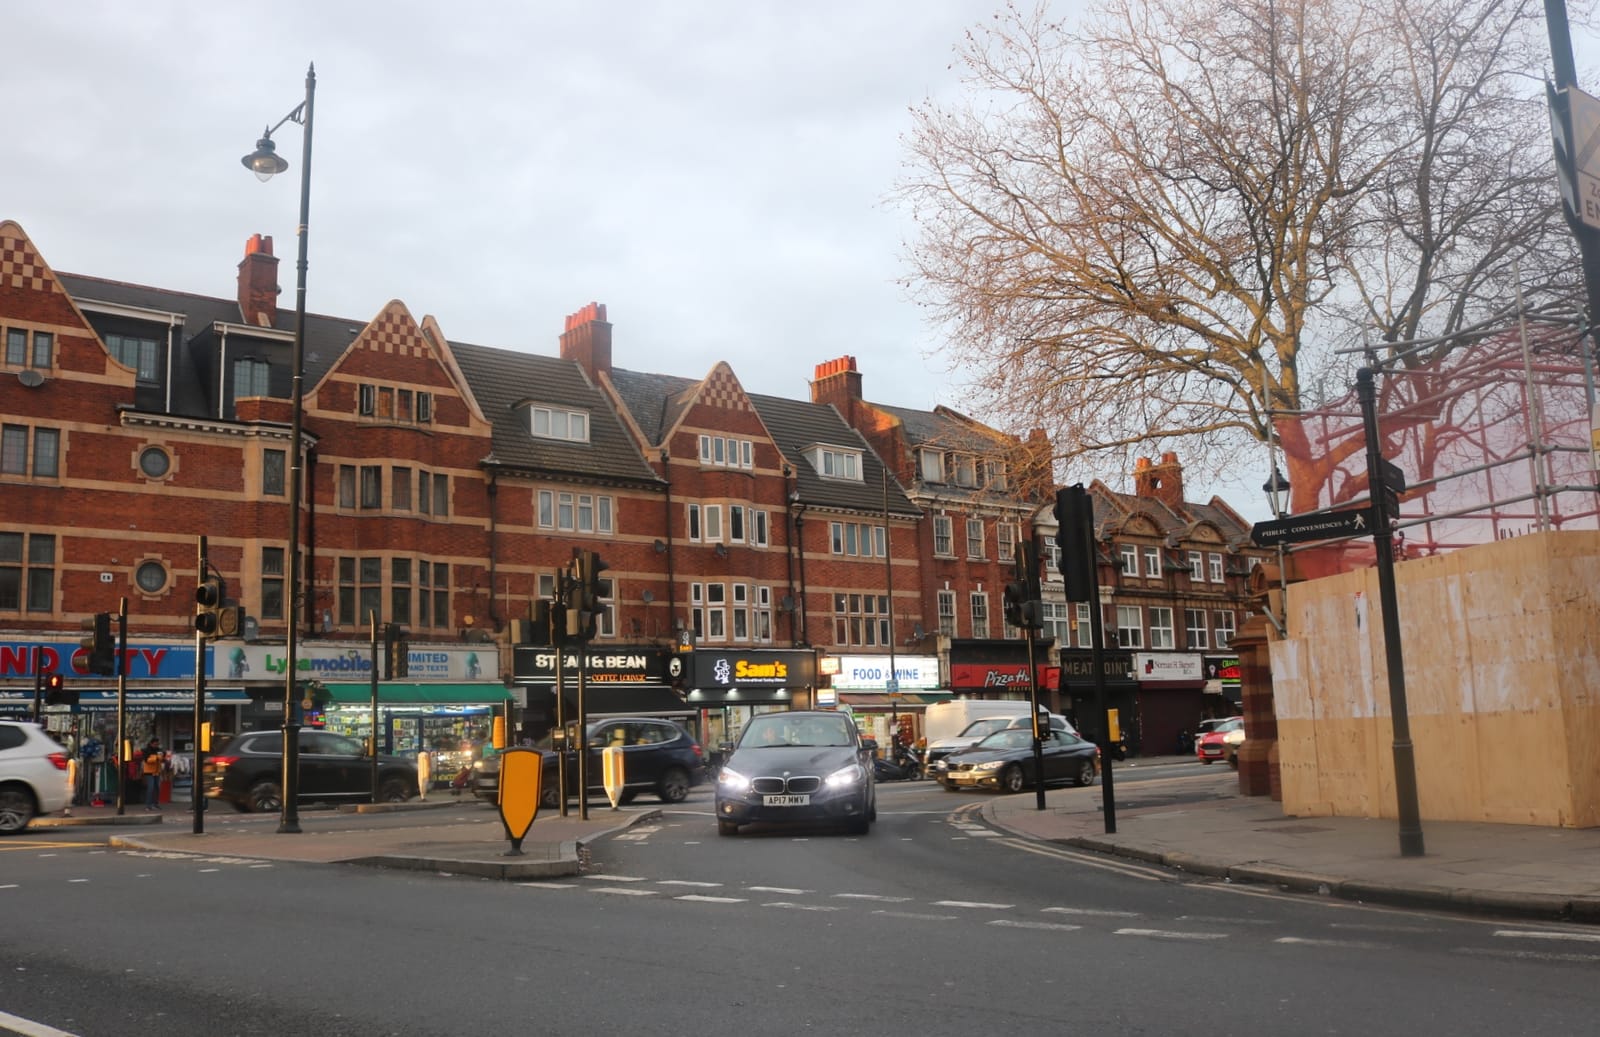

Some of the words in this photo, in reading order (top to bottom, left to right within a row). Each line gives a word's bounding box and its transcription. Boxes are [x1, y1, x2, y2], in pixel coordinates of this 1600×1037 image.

[1262, 528, 1287, 537] PUBLIC
[1291, 521, 1342, 534] CONVENIENCES
[70, 647, 168, 676] CTY
[265, 651, 373, 675] Lyamobile
[592, 655, 604, 668] &
[606, 655, 646, 670] BEAN
[735, 660, 787, 678] Sam's
[1064, 662, 1093, 675] MEAT
[1103, 661, 1129, 675] OINT
[853, 668, 881, 680] FOOD
[894, 668, 919, 680] WINE
[984, 671, 1014, 688] Pizza
[1015, 669, 1031, 684] Hu
[769, 796, 786, 804] AP17
